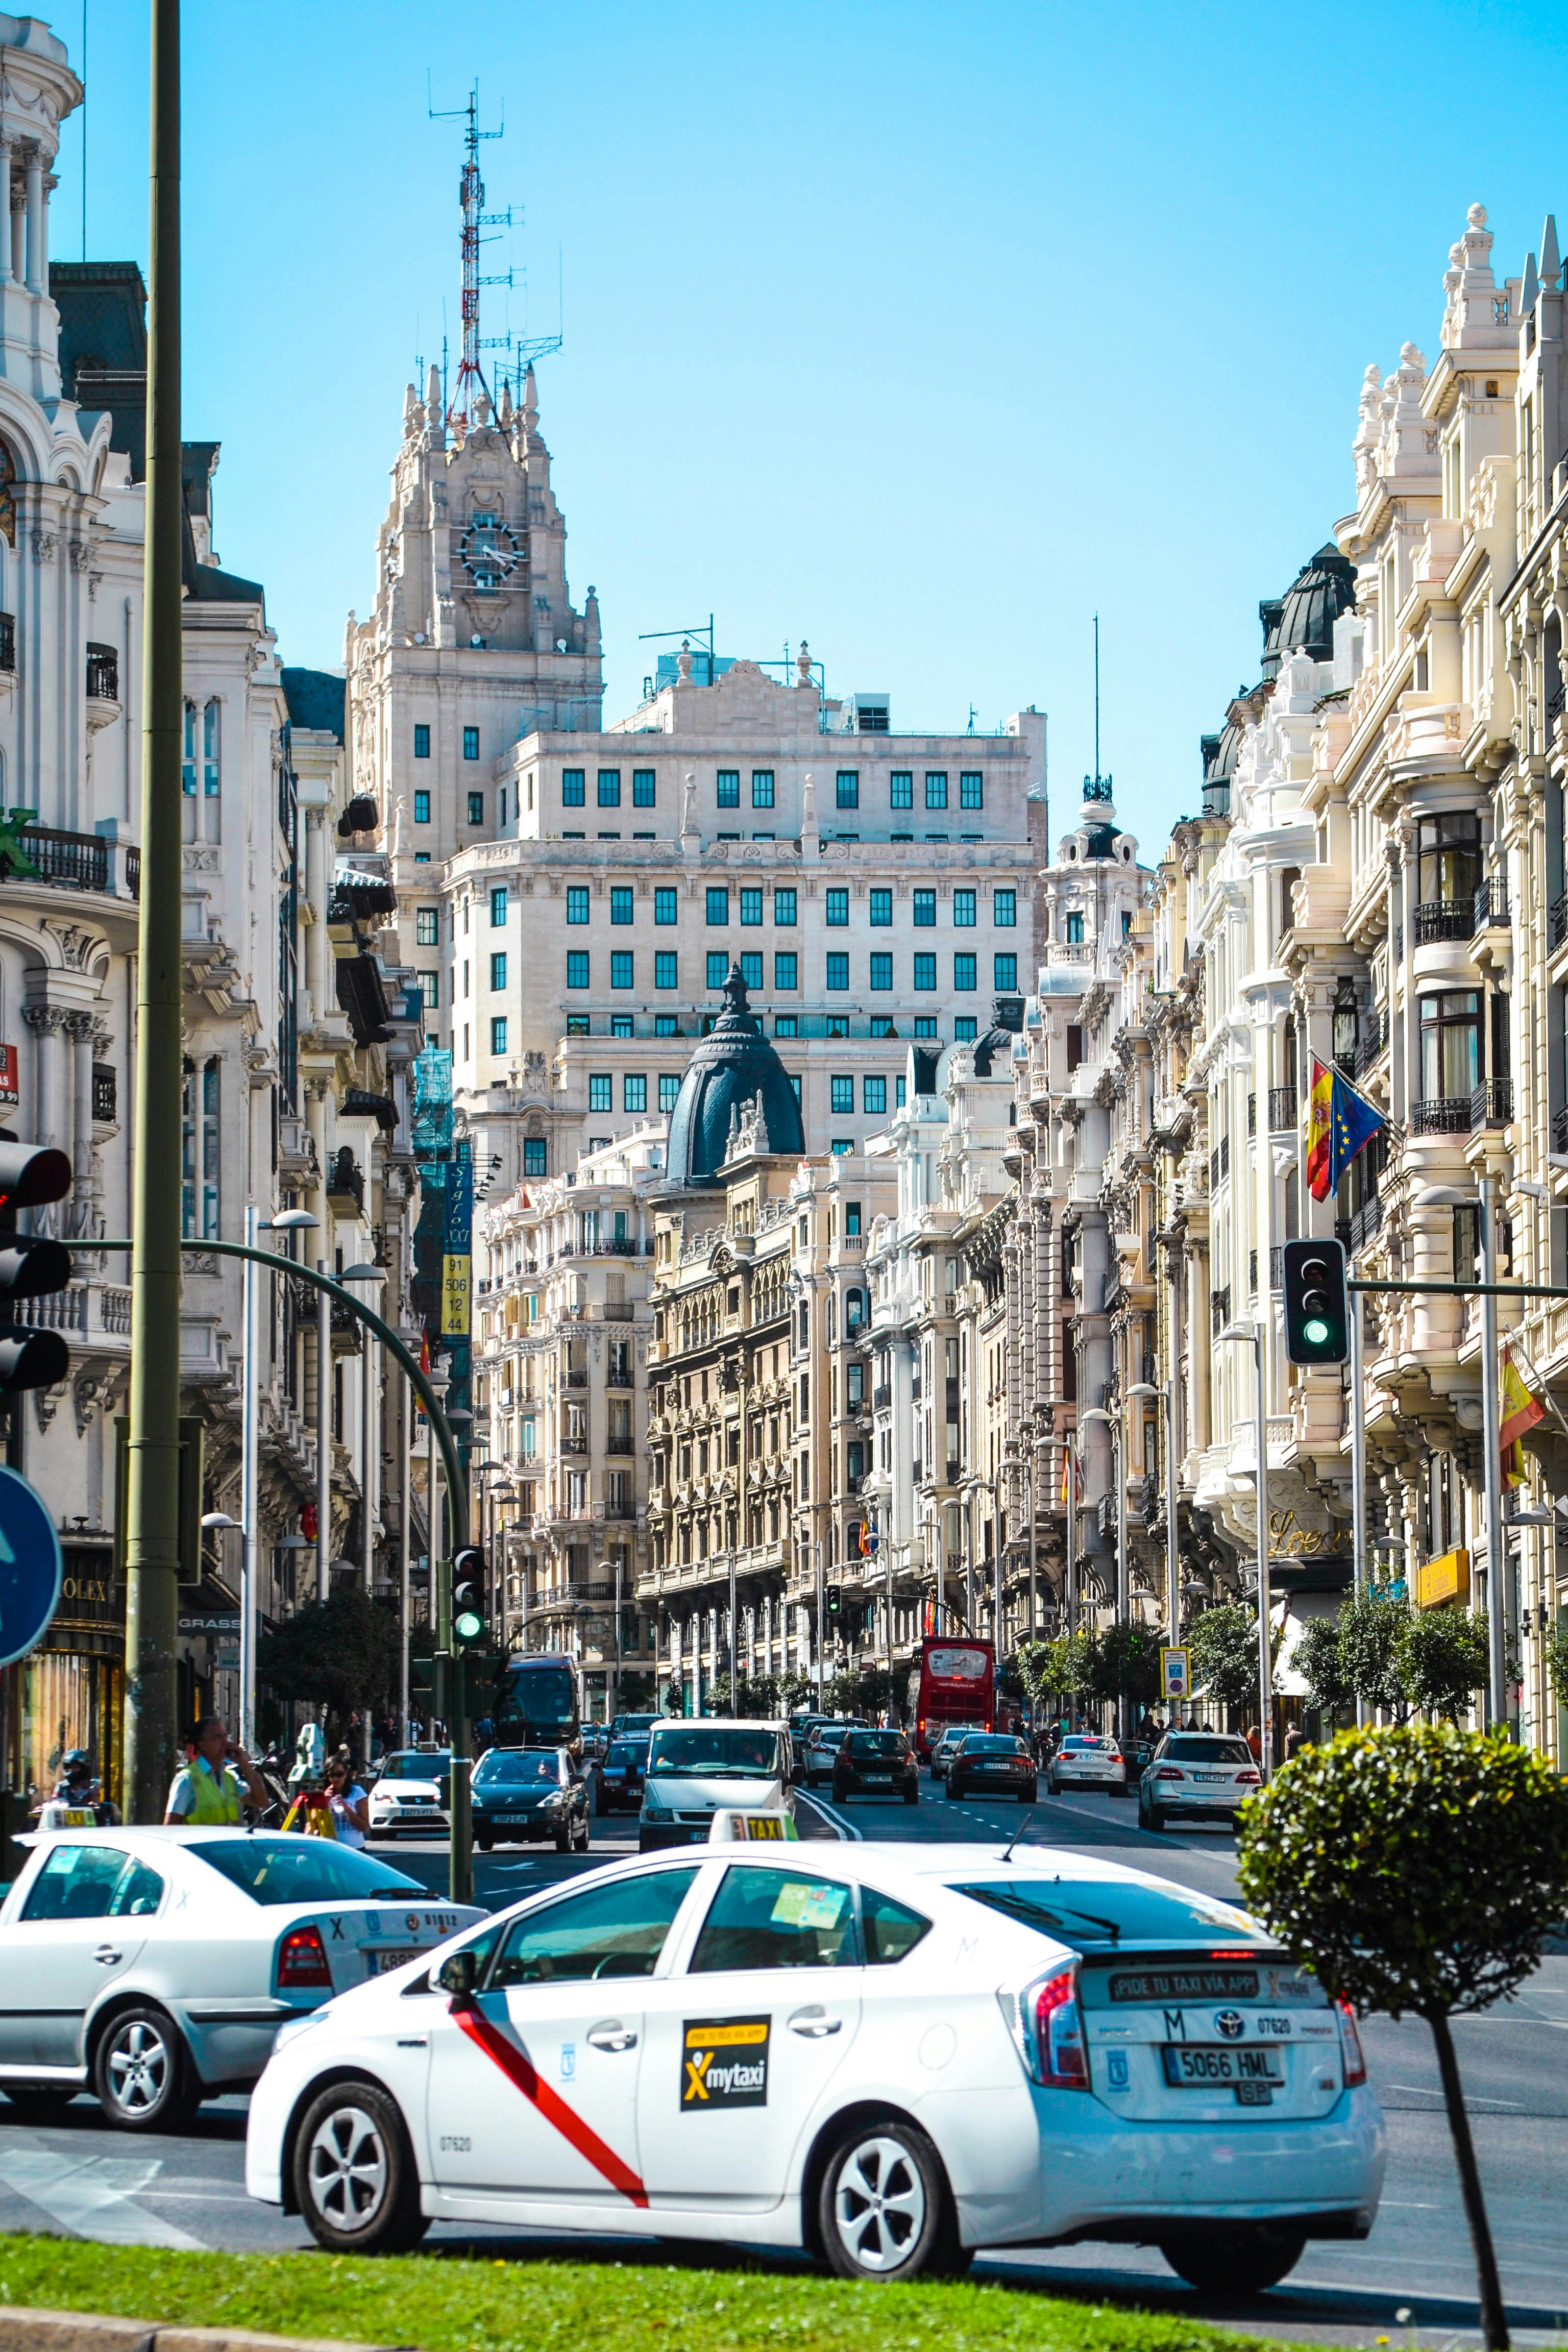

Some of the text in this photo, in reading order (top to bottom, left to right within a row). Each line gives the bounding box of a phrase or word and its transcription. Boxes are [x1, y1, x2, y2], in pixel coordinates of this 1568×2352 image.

[452, 1166, 465, 1224] Siglo
[445, 1229, 470, 1243] XXI
[449, 1259, 462, 1272] 91
[445, 1279, 467, 1292] 506
[449, 1298, 462, 1311] 12
[448, 1318, 462, 1331] 44
[59, 1578, 106, 1601] OLEX
[748, 1820, 782, 1840] TAXI
[330, 1918, 345, 1940] X
[1152, 1977, 1169, 1993] TU
[1173, 1976, 1200, 1993] TAXI
[1163, 2009, 1187, 2041] M
[1258, 2018, 1291, 2034] 07620
[1183, 2052, 1276, 2078] 5066 HML
[706, 2059, 765, 2094] mytaxi
[1243, 2084, 1267, 2101] SP
